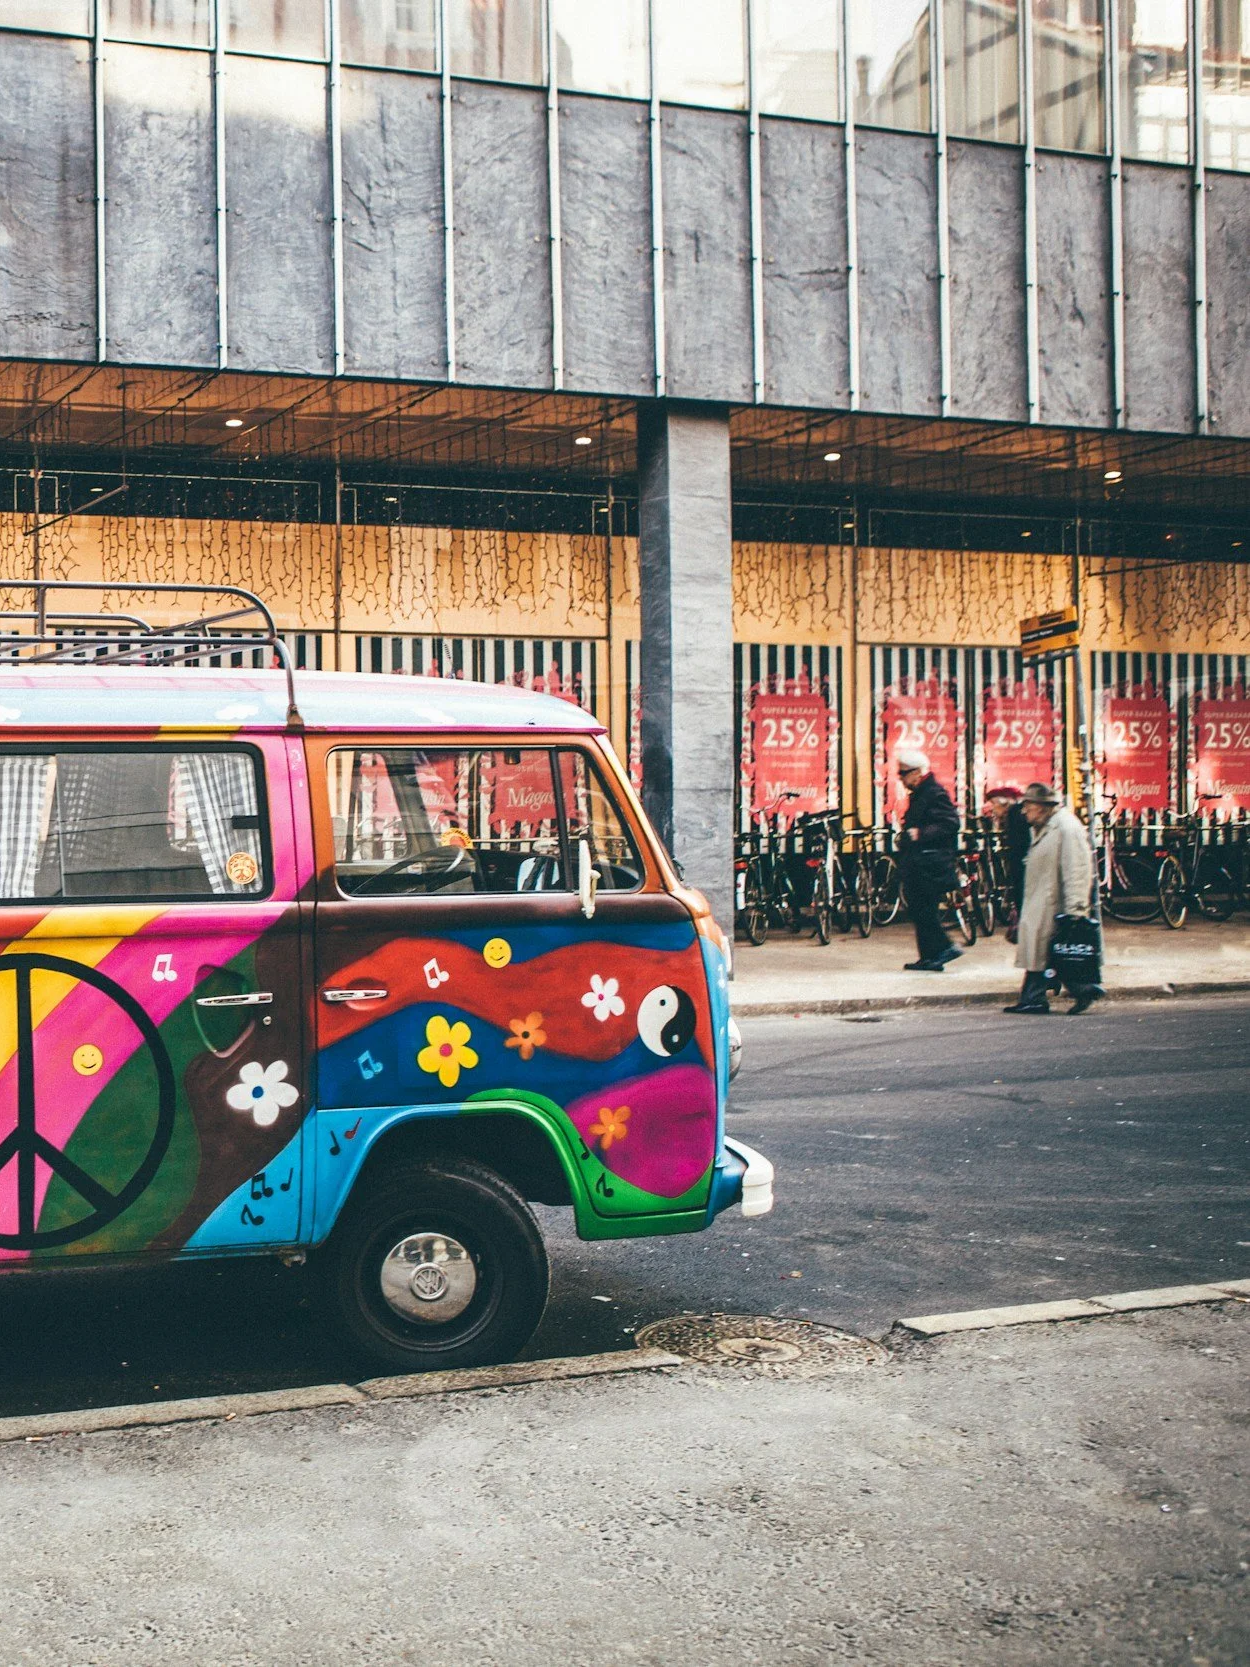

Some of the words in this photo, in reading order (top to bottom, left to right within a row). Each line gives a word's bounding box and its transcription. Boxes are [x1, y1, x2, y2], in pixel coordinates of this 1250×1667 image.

[761, 718, 819, 748] 25%
[893, 720, 949, 748] 25%
[993, 720, 1046, 748] 25%
[1113, 721, 1162, 749] 25%
[1204, 722, 1250, 749] 25%
